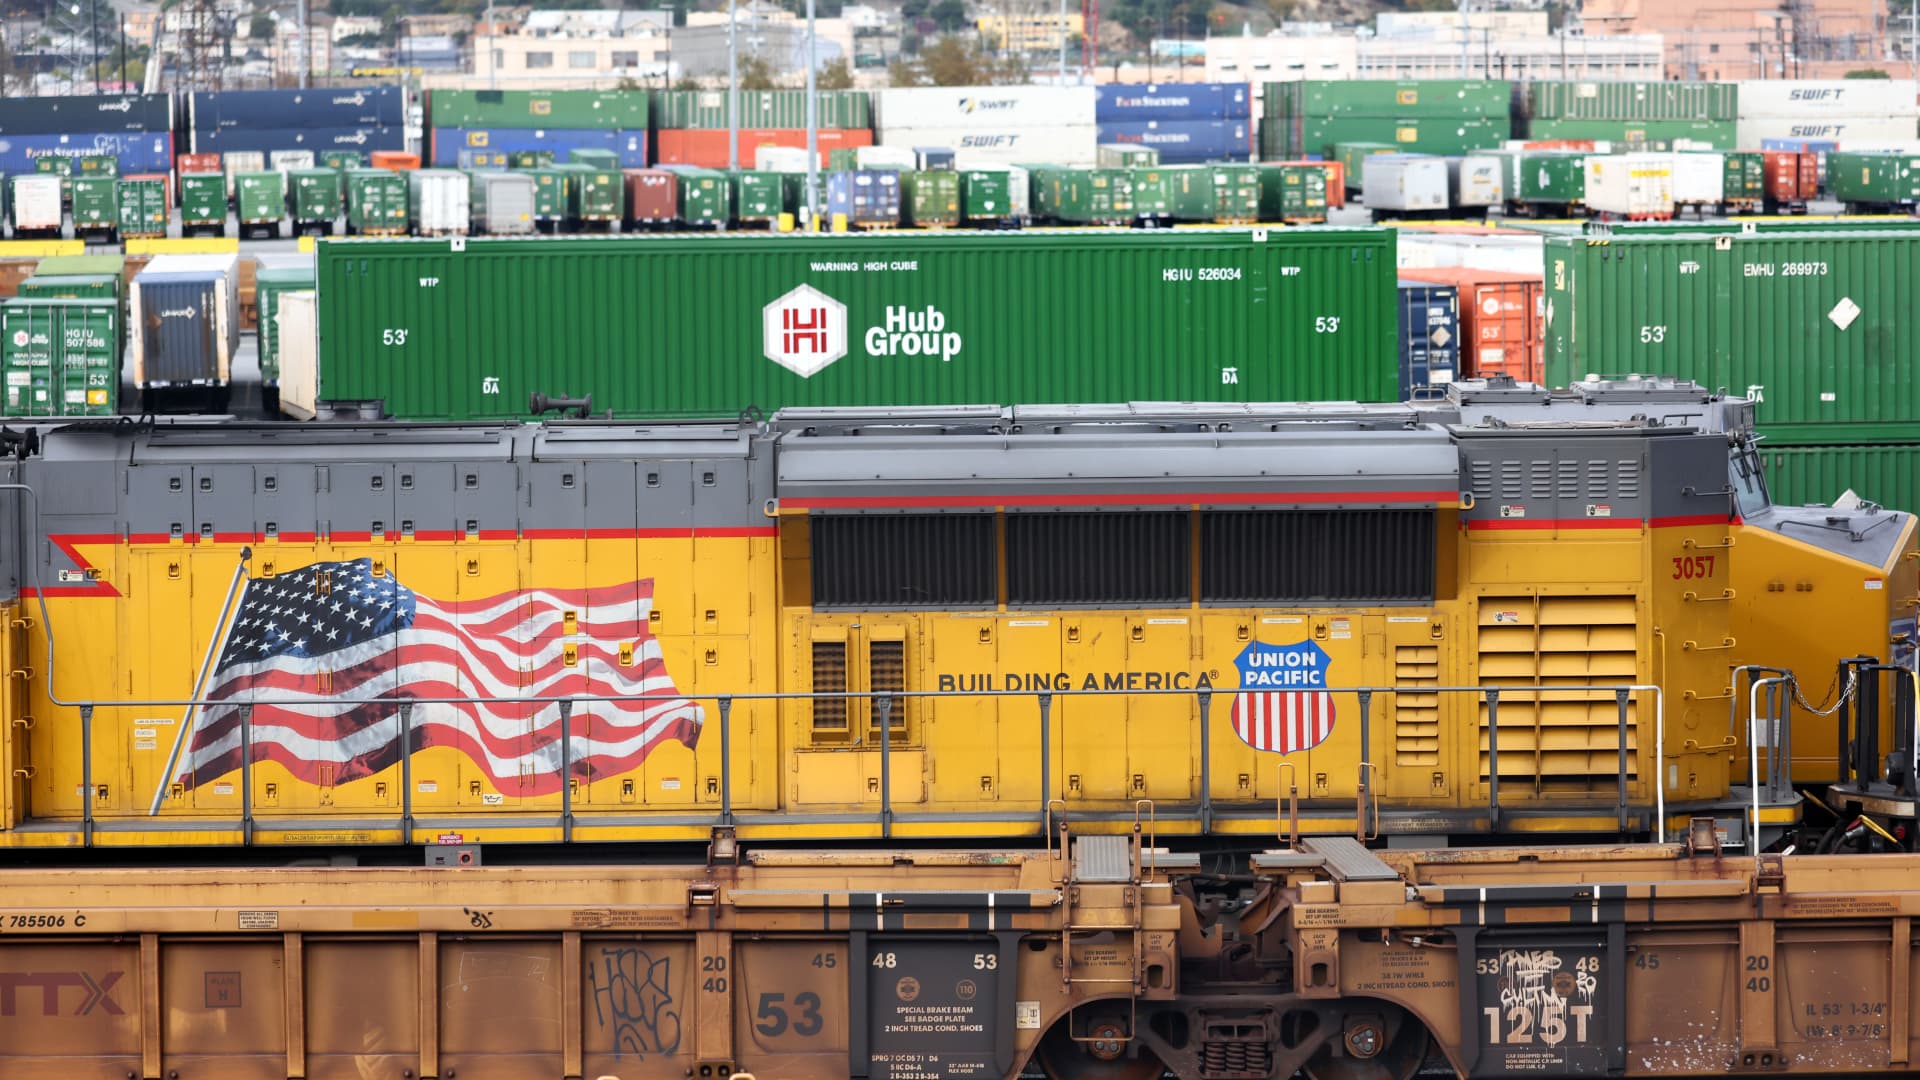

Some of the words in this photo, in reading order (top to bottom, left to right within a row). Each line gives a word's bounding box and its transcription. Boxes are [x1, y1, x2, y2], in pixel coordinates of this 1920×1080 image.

[1789, 88, 1845, 101] SWIFT
[1789, 125, 1847, 137] SWIFT
[960, 135, 1021, 147] SWIFT
[811, 262, 858, 271] WARNING
[864, 262, 887, 271] HIGH
[891, 261, 917, 270] CUBE
[1281, 267, 1300, 276] WTP
[1680, 264, 1700, 274] WTP
[1744, 263, 1775, 276] EMHU
[1782, 262, 1827, 276] 269973
[1163, 268, 1193, 281] HGIU
[1199, 268, 1241, 281] 526034
[420, 277, 439, 288] WTP
[886, 305, 944, 333] Hub
[1315, 317, 1340, 333] 53'
[383, 328, 408, 346] 53'
[1641, 326, 1667, 344] 53'
[865, 326, 961, 361] Group
[1222, 370, 1238, 384] DA
[482, 381, 499, 394] DA
[1672, 555, 1715, 580] 3057
[1248, 652, 1316, 667] UNION
[938, 673, 1071, 692] BUILDING
[1245, 670, 1320, 685] PACIFIC
[10, 915, 65, 928] 785506
[74, 914, 87, 927] C
[703, 957, 726, 971] 20
[811, 953, 836, 968] 45
[873, 953, 897, 968] 48
[974, 954, 998, 969] 53
[1476, 959, 1499, 974] 53
[1575, 957, 1600, 972] 48
[1635, 955, 1660, 970] 45
[1746, 955, 1769, 971] 20
[703, 978, 727, 993] 40
[960, 985, 973, 994] 110
[1746, 977, 1770, 992] 40
[0, 971, 125, 1016] TTX
[756, 991, 823, 1036] 53
[896, 1006, 925, 1014] SPECIAL
[926, 1006, 951, 1014] BRAKE
[952, 1006, 973, 1014] BEAM
[1806, 1003, 1816, 1015] IL
[1822, 1002, 1842, 1015] 53'
[918, 1015, 943, 1023] BADGE
[1484, 1006, 1593, 1045] 125T
